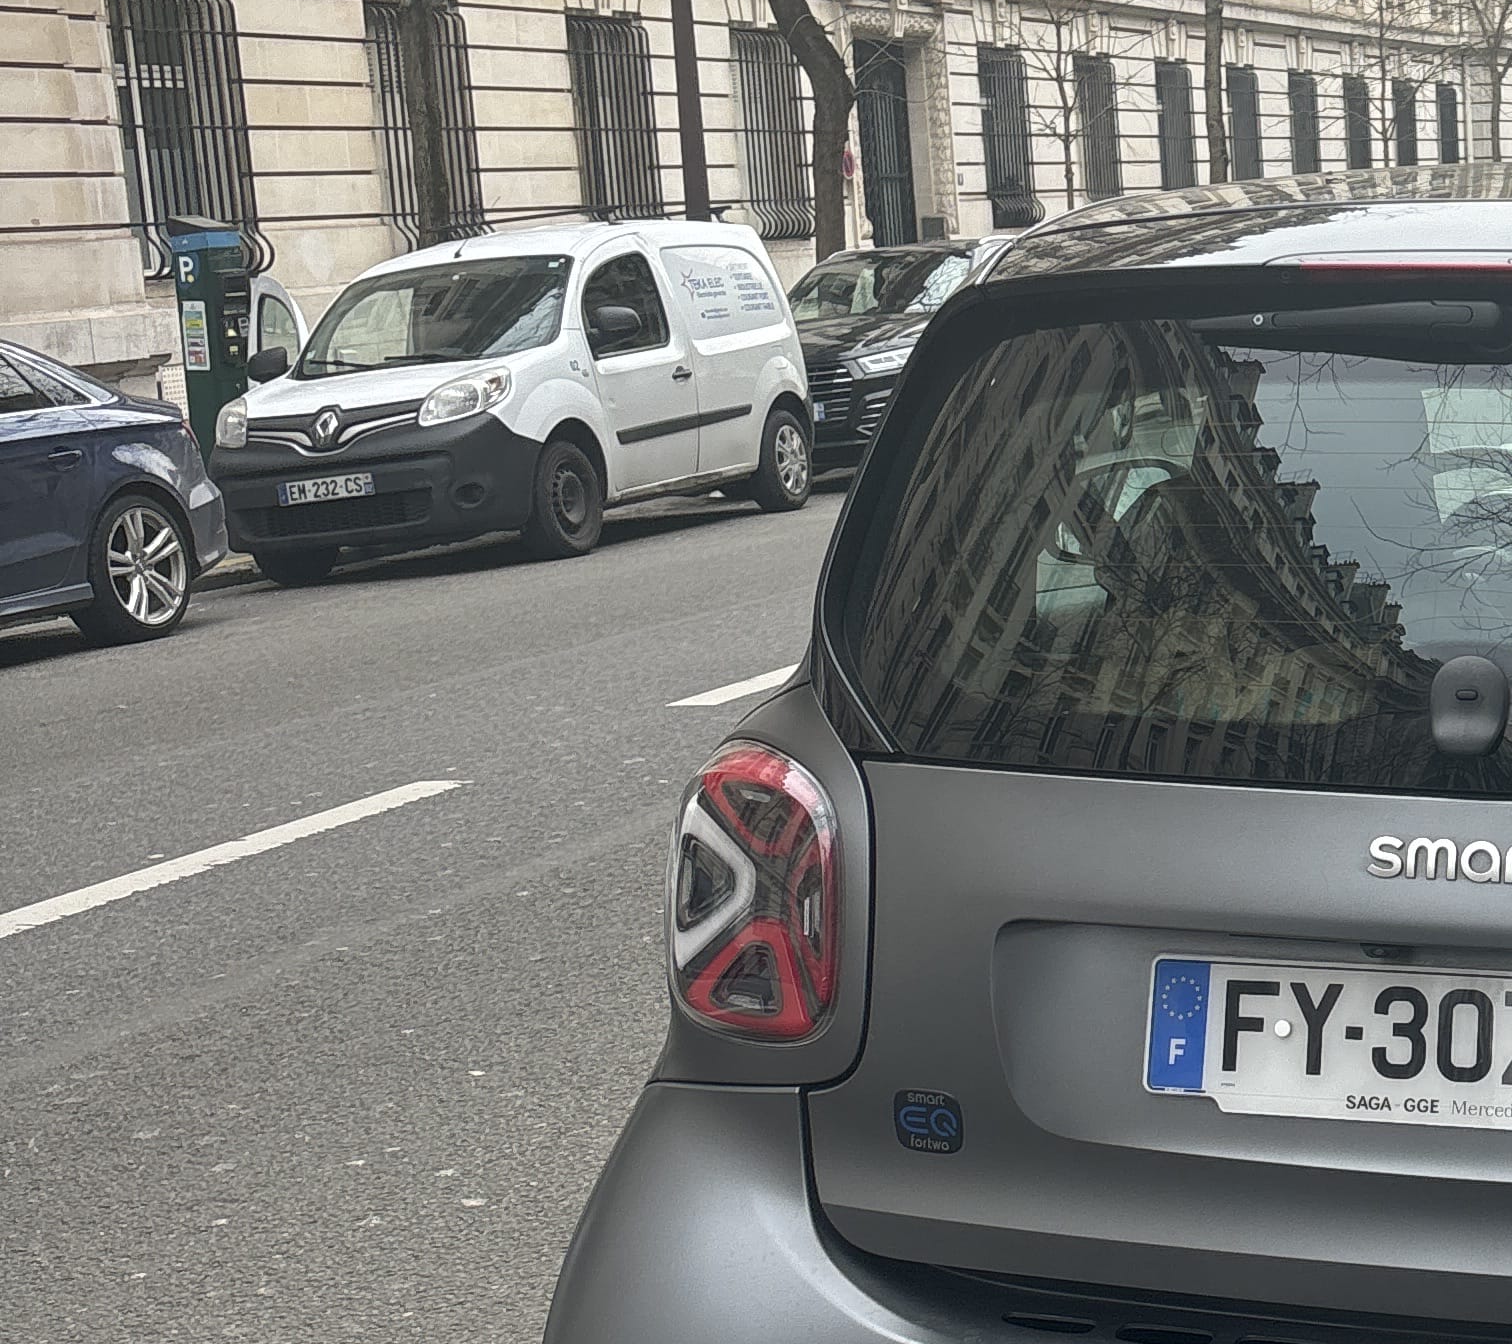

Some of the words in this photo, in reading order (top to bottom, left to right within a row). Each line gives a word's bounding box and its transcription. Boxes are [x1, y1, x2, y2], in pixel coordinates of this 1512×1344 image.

[1168, 1038, 1186, 1065] F
[907, 1092, 944, 1105] smart
[1345, 1095, 1392, 1112] SAGA
[1403, 1098, 1440, 1114] GGE
[900, 1106, 957, 1136] EQ
[910, 1134, 949, 1150] fortwo
